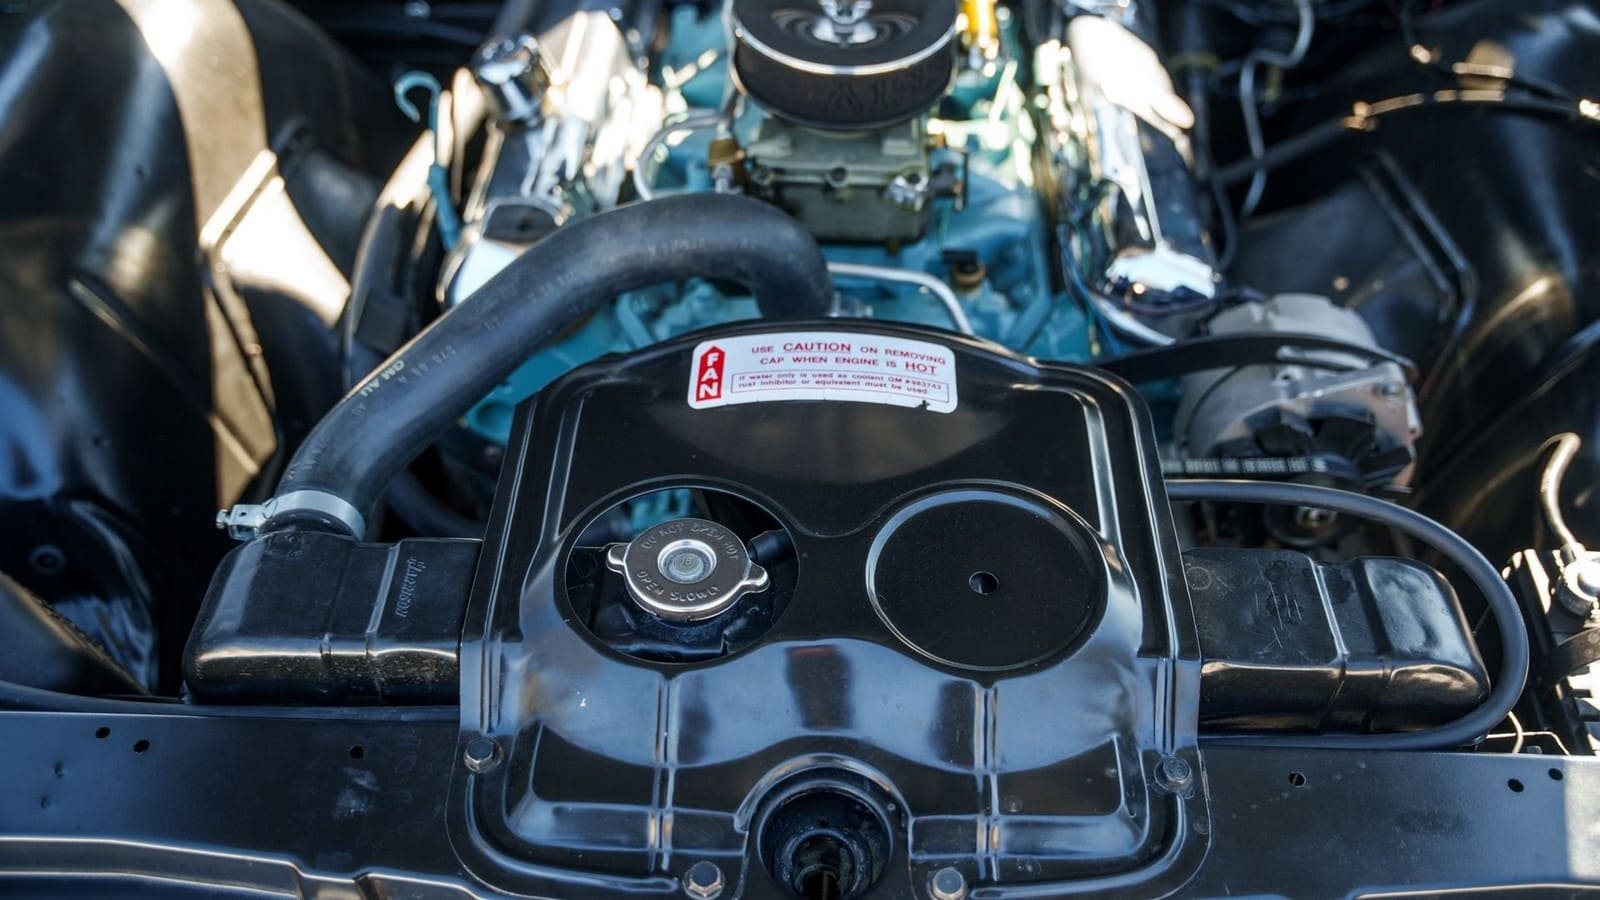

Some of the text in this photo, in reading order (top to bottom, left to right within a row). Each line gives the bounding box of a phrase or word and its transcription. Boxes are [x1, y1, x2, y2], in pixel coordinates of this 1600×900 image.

[752, 342, 946, 365] USE CAUTION ON REMOVING
[760, 357, 784, 365] CAP
[792, 355, 828, 364] WHEN
[834, 357, 880, 366] ENGINE
[905, 361, 937, 375] HOT
[699, 352, 720, 400] FAN
[636, 569, 721, 602] OPEN SLOWLY
